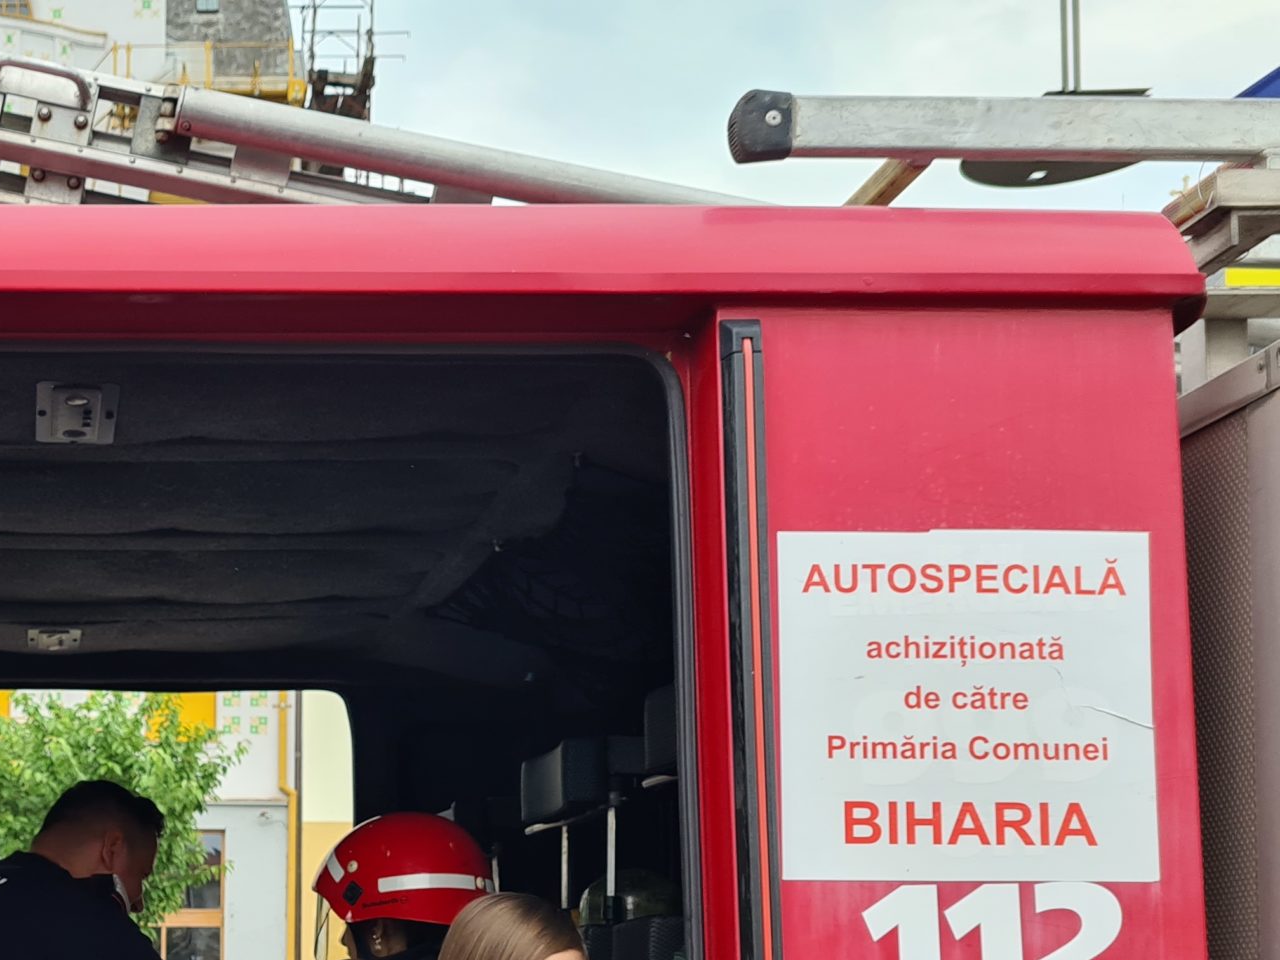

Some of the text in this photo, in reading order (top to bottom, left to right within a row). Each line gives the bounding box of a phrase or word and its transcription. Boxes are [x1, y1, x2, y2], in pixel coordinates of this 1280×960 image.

[803, 560, 1125, 596] AUTOSPECIALĂ
[867, 636, 1064, 665] achiziționată
[904, 687, 1028, 710] de către
[828, 736, 1108, 761] Primăria Comunei
[844, 801, 1098, 847] BIHARIA
